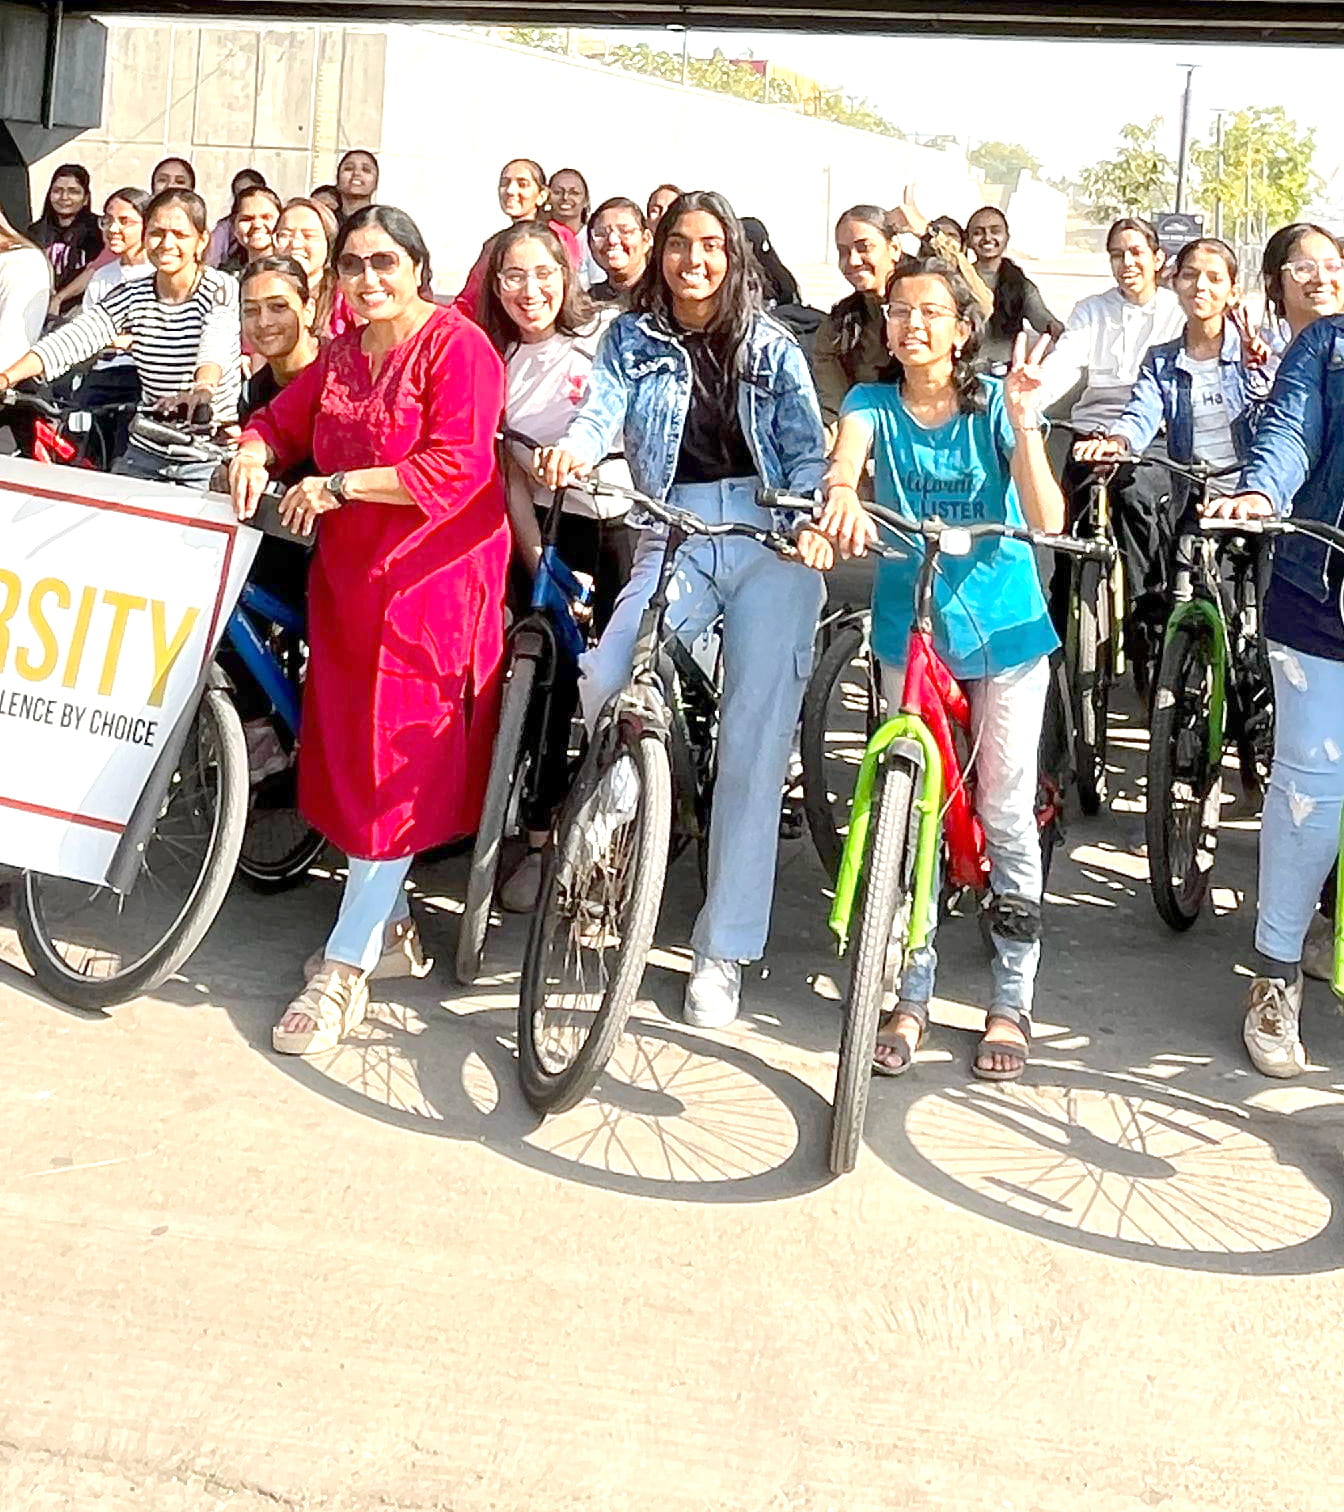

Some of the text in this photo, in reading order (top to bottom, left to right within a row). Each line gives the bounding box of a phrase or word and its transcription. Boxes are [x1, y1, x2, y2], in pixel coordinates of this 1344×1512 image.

[899, 469, 986, 500] liforni
[60, 703, 87, 730] BY
[89, 709, 158, 747] CHOICE
